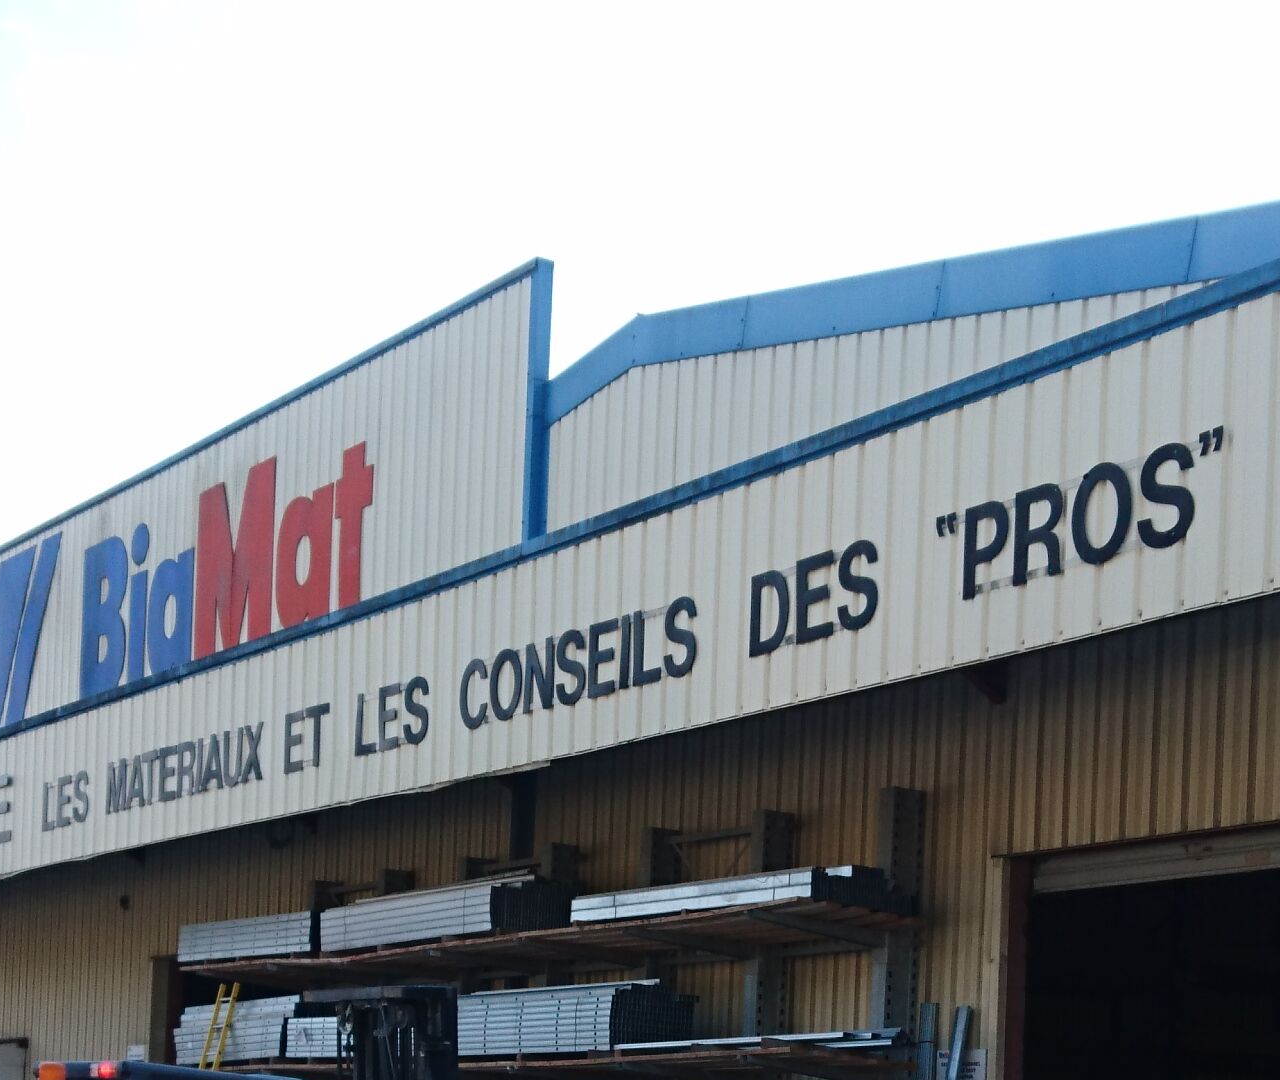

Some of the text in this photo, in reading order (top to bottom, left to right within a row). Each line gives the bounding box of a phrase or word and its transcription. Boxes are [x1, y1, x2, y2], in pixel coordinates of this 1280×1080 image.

[42, 770, 89, 832] LES
[105, 722, 264, 815] MATERIAUX
[283, 702, 330, 771] ET
[354, 677, 429, 757] LES
[459, 596, 698, 729] CONSEILS
[748, 539, 879, 658] DES
[79, 441, 374, 701] BigMat
